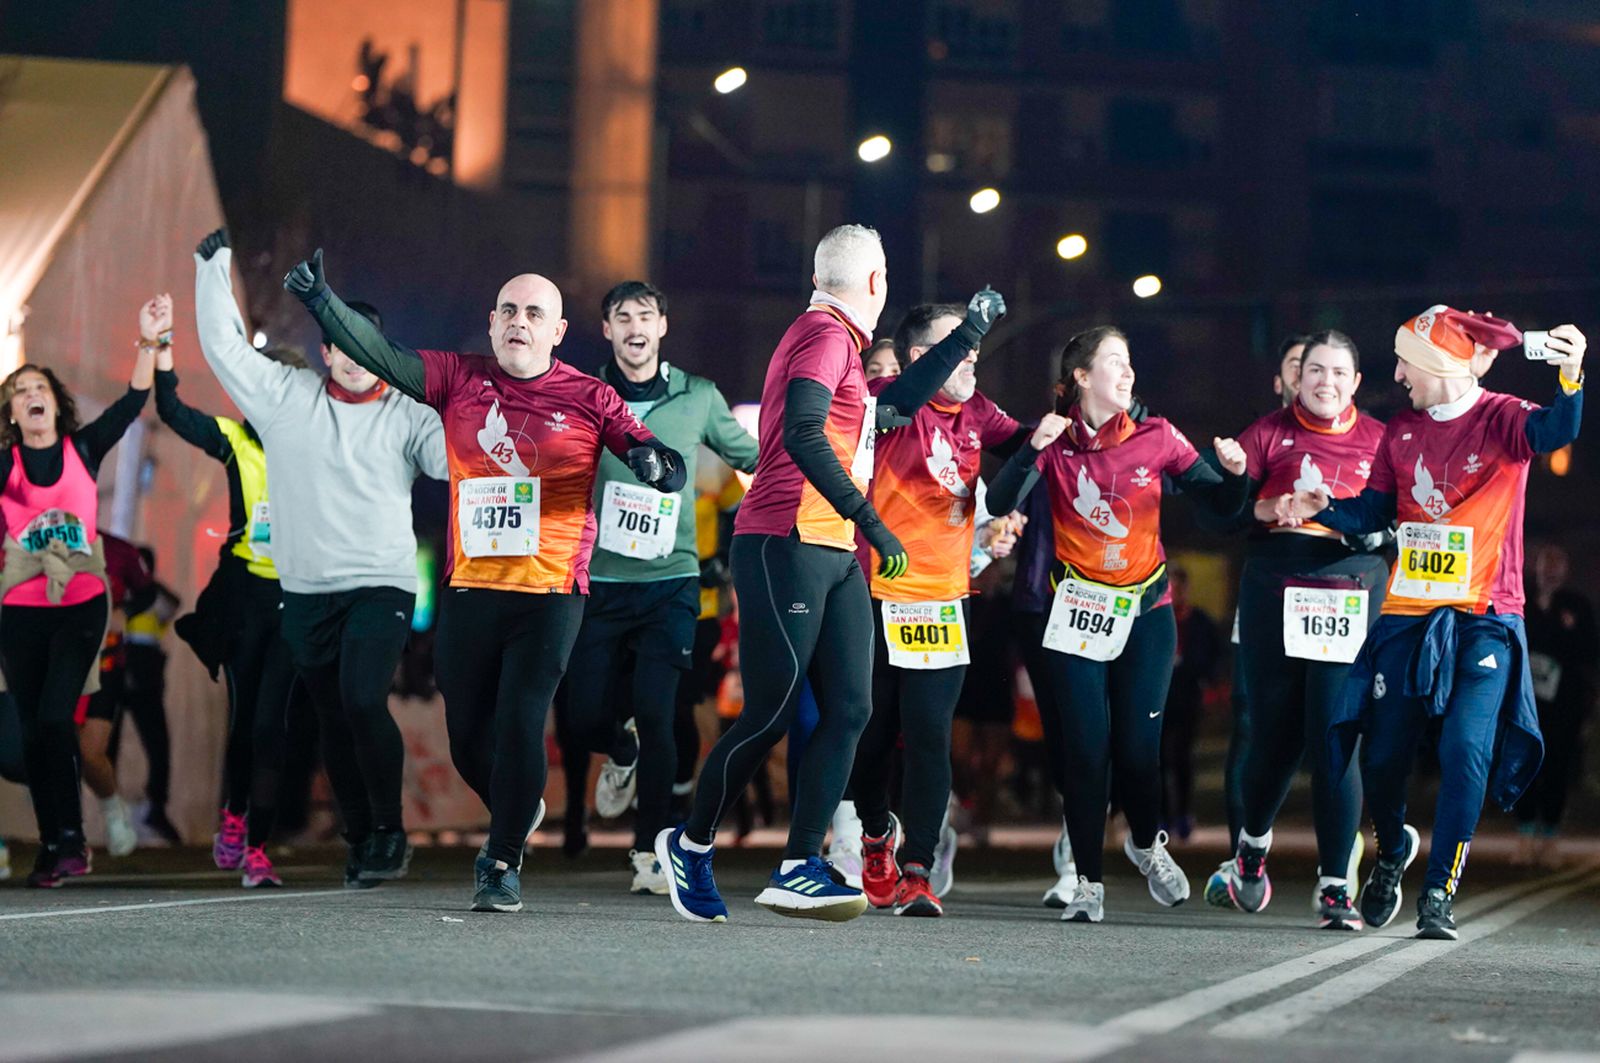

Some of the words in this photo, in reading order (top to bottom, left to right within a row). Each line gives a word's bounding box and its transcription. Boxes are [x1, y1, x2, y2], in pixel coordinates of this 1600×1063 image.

[490, 441, 514, 464] 43
[938, 466, 956, 486] 43
[497, 485, 507, 494] DE
[613, 498, 626, 508] SAN
[1425, 495, 1444, 516] 43
[472, 506, 522, 529] 4375
[617, 509, 660, 536] 7061
[1090, 506, 1110, 527] 43
[1408, 550, 1456, 575] 6402
[1064, 595, 1078, 606] SAN
[1074, 591, 1096, 602] NOCHE
[1098, 595, 1108, 604] DE
[899, 607, 921, 615] NOCHE
[1295, 605, 1310, 613] SAN
[1068, 608, 1116, 637] 1694
[1301, 614, 1350, 637] 1693
[900, 624, 949, 645] 6401
